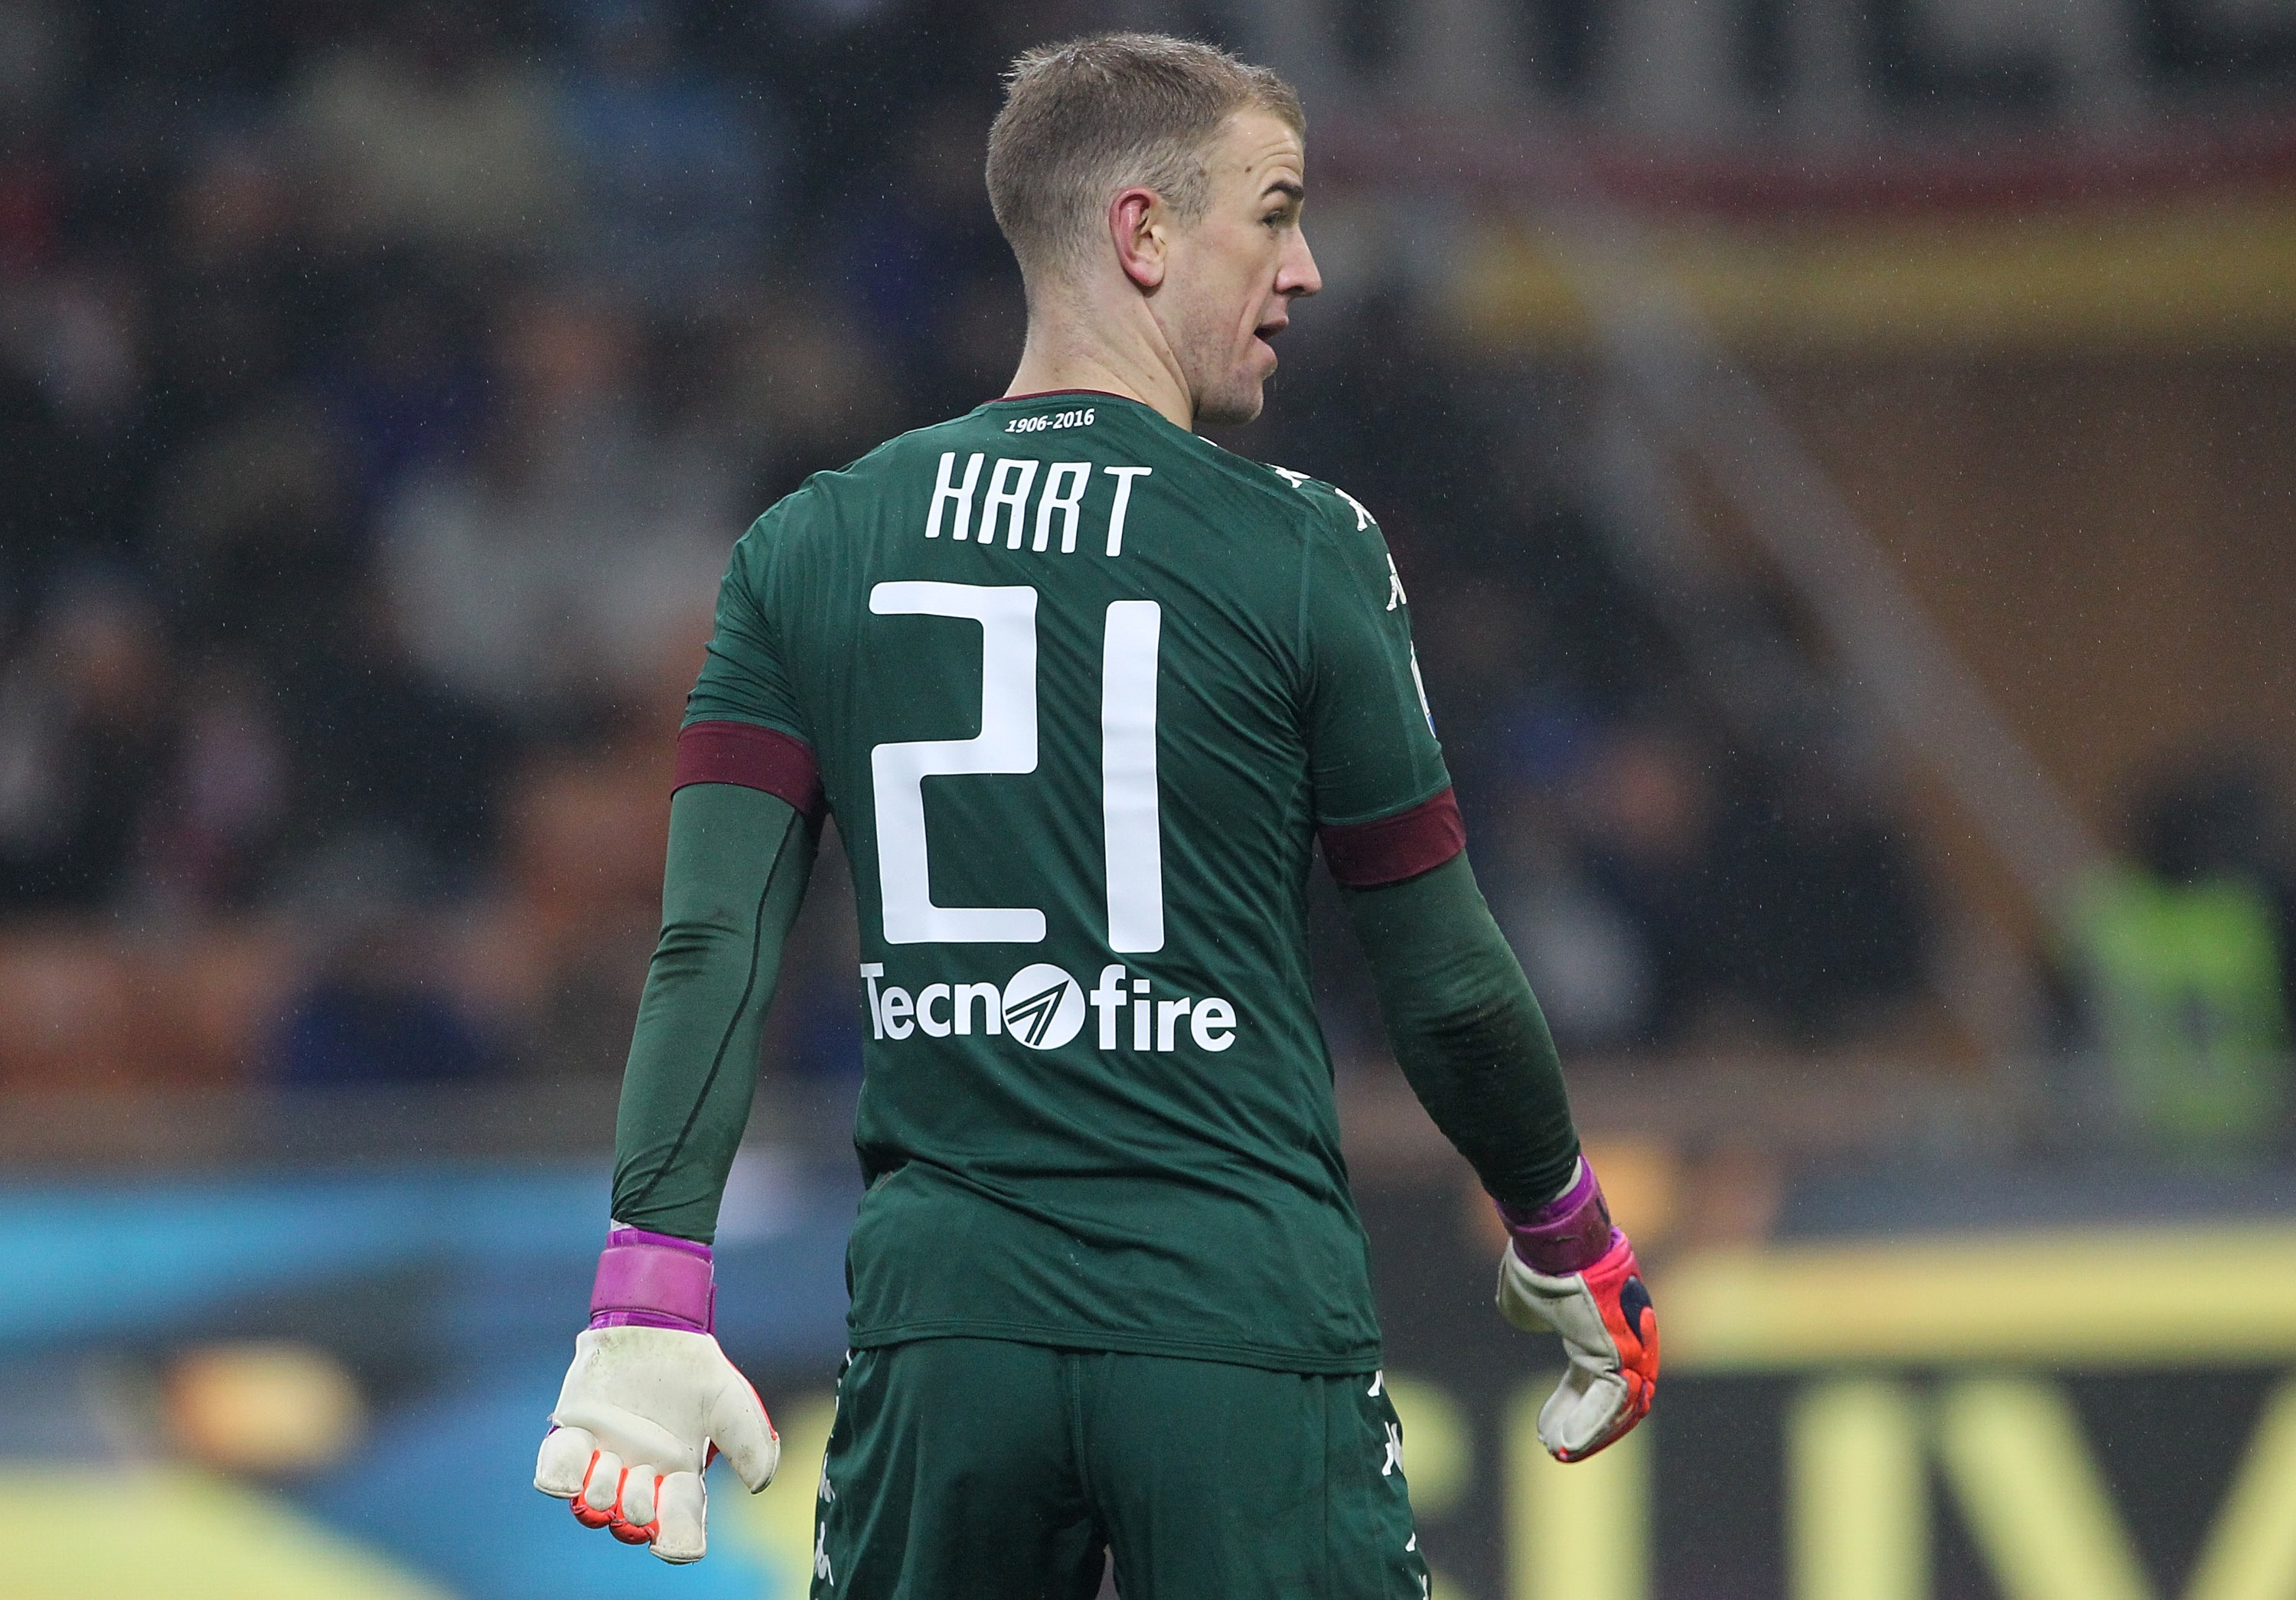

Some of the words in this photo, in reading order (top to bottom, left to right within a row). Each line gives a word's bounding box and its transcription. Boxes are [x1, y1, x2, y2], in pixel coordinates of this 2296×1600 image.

[1005, 408, 1095, 433] 1906-2016
[925, 452, 1153, 557] HART
[868, 580, 1165, 953] 21
